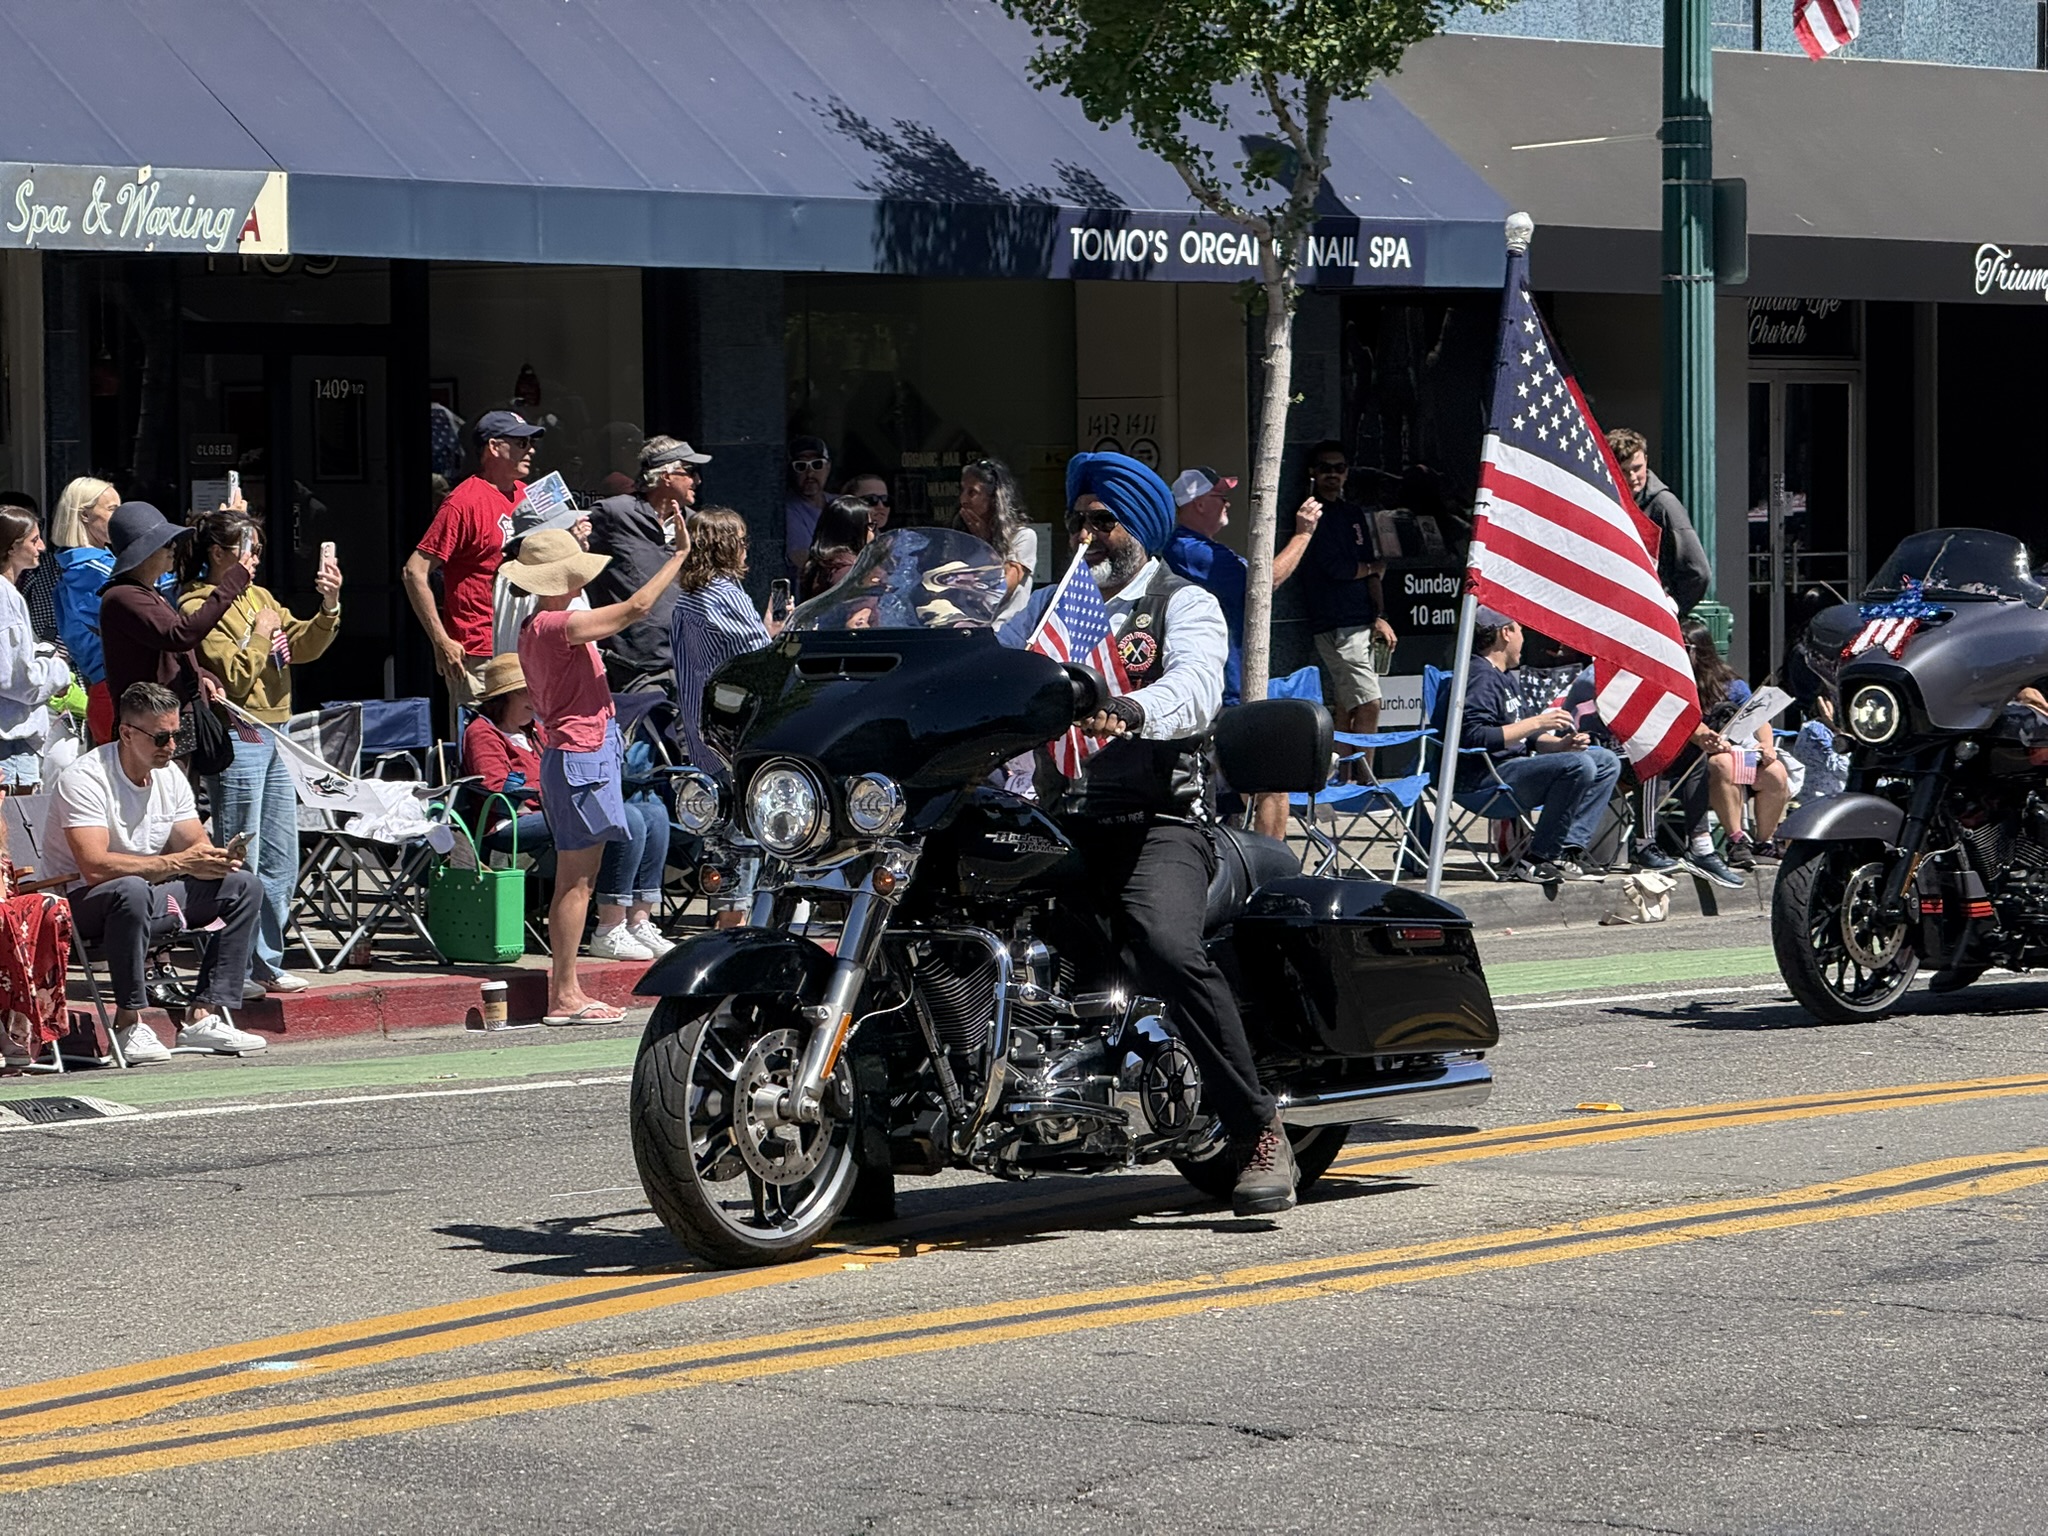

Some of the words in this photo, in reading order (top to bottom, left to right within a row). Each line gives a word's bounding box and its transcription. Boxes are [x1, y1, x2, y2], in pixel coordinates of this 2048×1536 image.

[7, 179, 71, 245] Spa
[82, 176, 112, 235] &
[116, 181, 235, 253] Waxing
[1070, 227, 1168, 263] TOMO'S
[1179, 231, 1283, 267] ORGA
[1307, 235, 1360, 268] NAIL
[1369, 236, 1412, 269] SPA
[1975, 243, 2048, 303] Trium
[1748, 314, 1808, 345] Church
[315, 379, 349, 399] 1409
[196, 444, 233, 456] CLOSED
[1404, 573, 1460, 597] Sunday
[1410, 605, 1429, 625] 10
[1432, 607, 1455, 625] am
